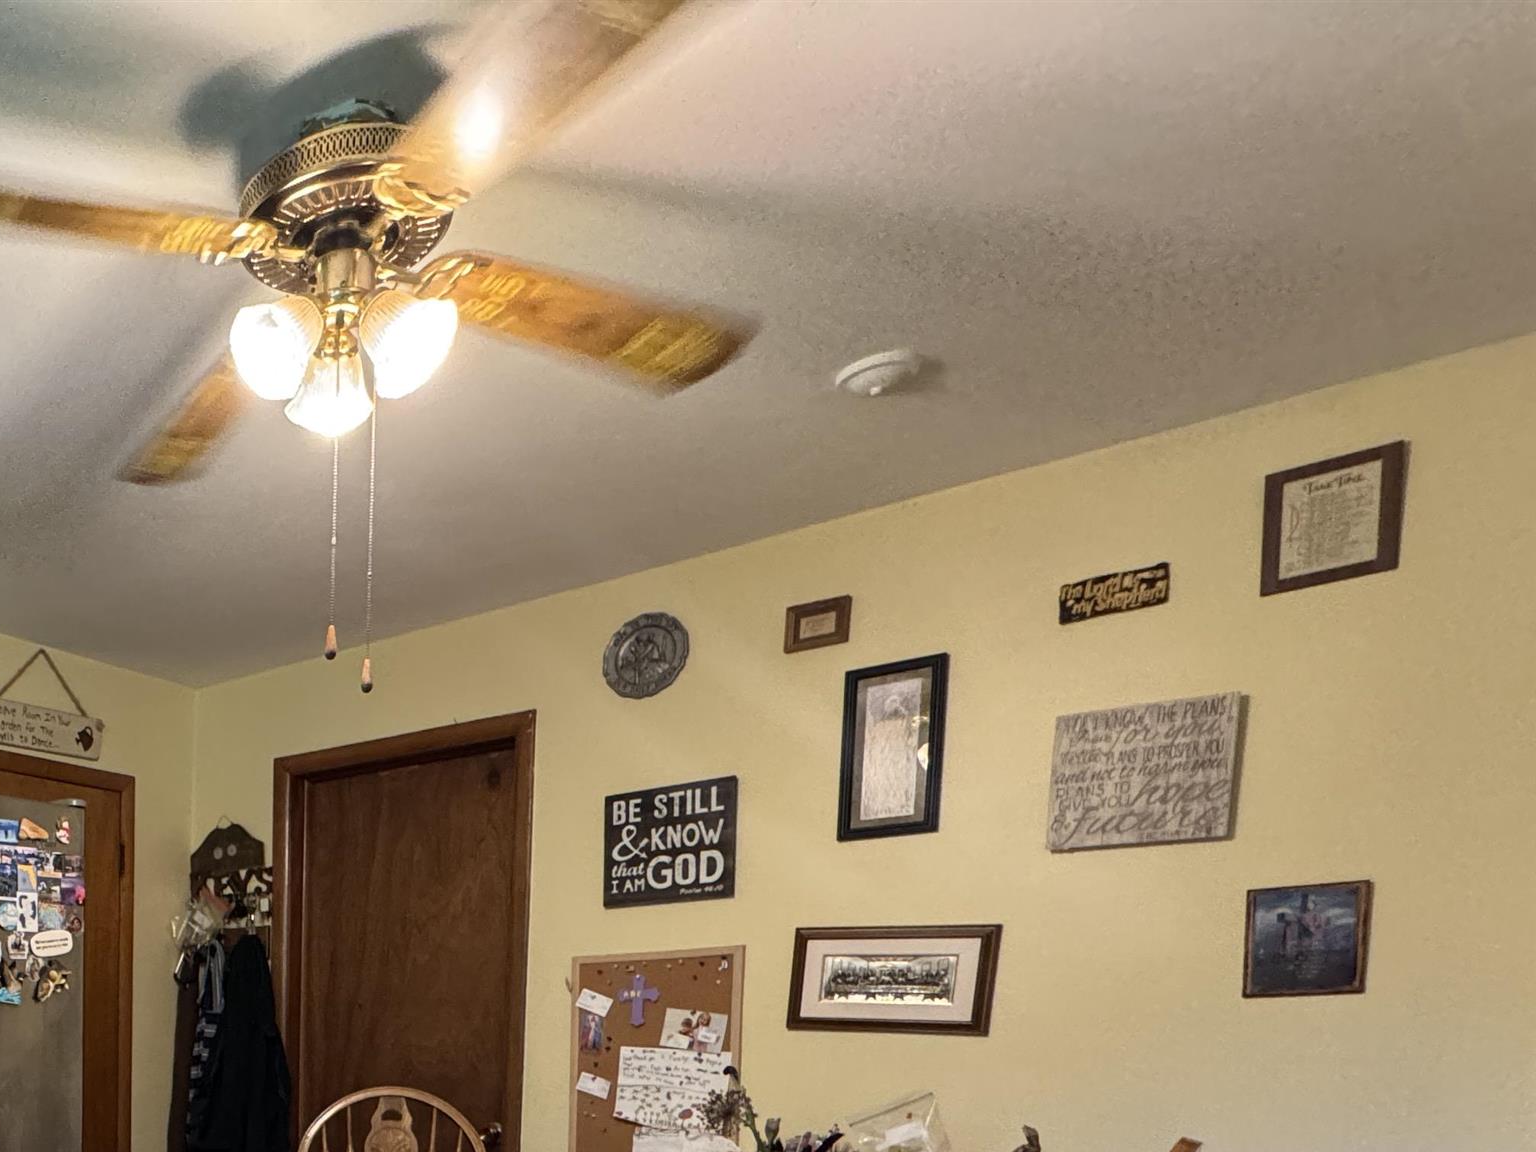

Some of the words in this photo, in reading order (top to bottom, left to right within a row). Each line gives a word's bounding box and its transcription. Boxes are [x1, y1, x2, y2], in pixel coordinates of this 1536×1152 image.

[1084, 573, 1122, 601] Lord
[1104, 706, 1149, 730] KNOW
[1158, 703, 1176, 722] THE
[1183, 696, 1226, 720] PLANS
[1142, 745, 1155, 763] TO
[1158, 741, 1199, 760] PROSPER
[1204, 737, 1225, 756] YOU
[1054, 767, 1089, 786] and
[1056, 783, 1104, 802] PLANS
[1114, 781, 1131, 795] TO
[613, 798, 642, 825] BE
[654, 786, 724, 818] STILL
[1100, 794, 1132, 809] YOU
[1131, 776, 1230, 813] hope
[611, 824, 649, 861] &
[650, 818, 724, 851] KNOW
[1055, 805, 1221, 848] future
[611, 862, 645, 878] that
[611, 880, 619, 894] I
[623, 878, 645, 893] AM
[646, 849, 724, 889] GOD
